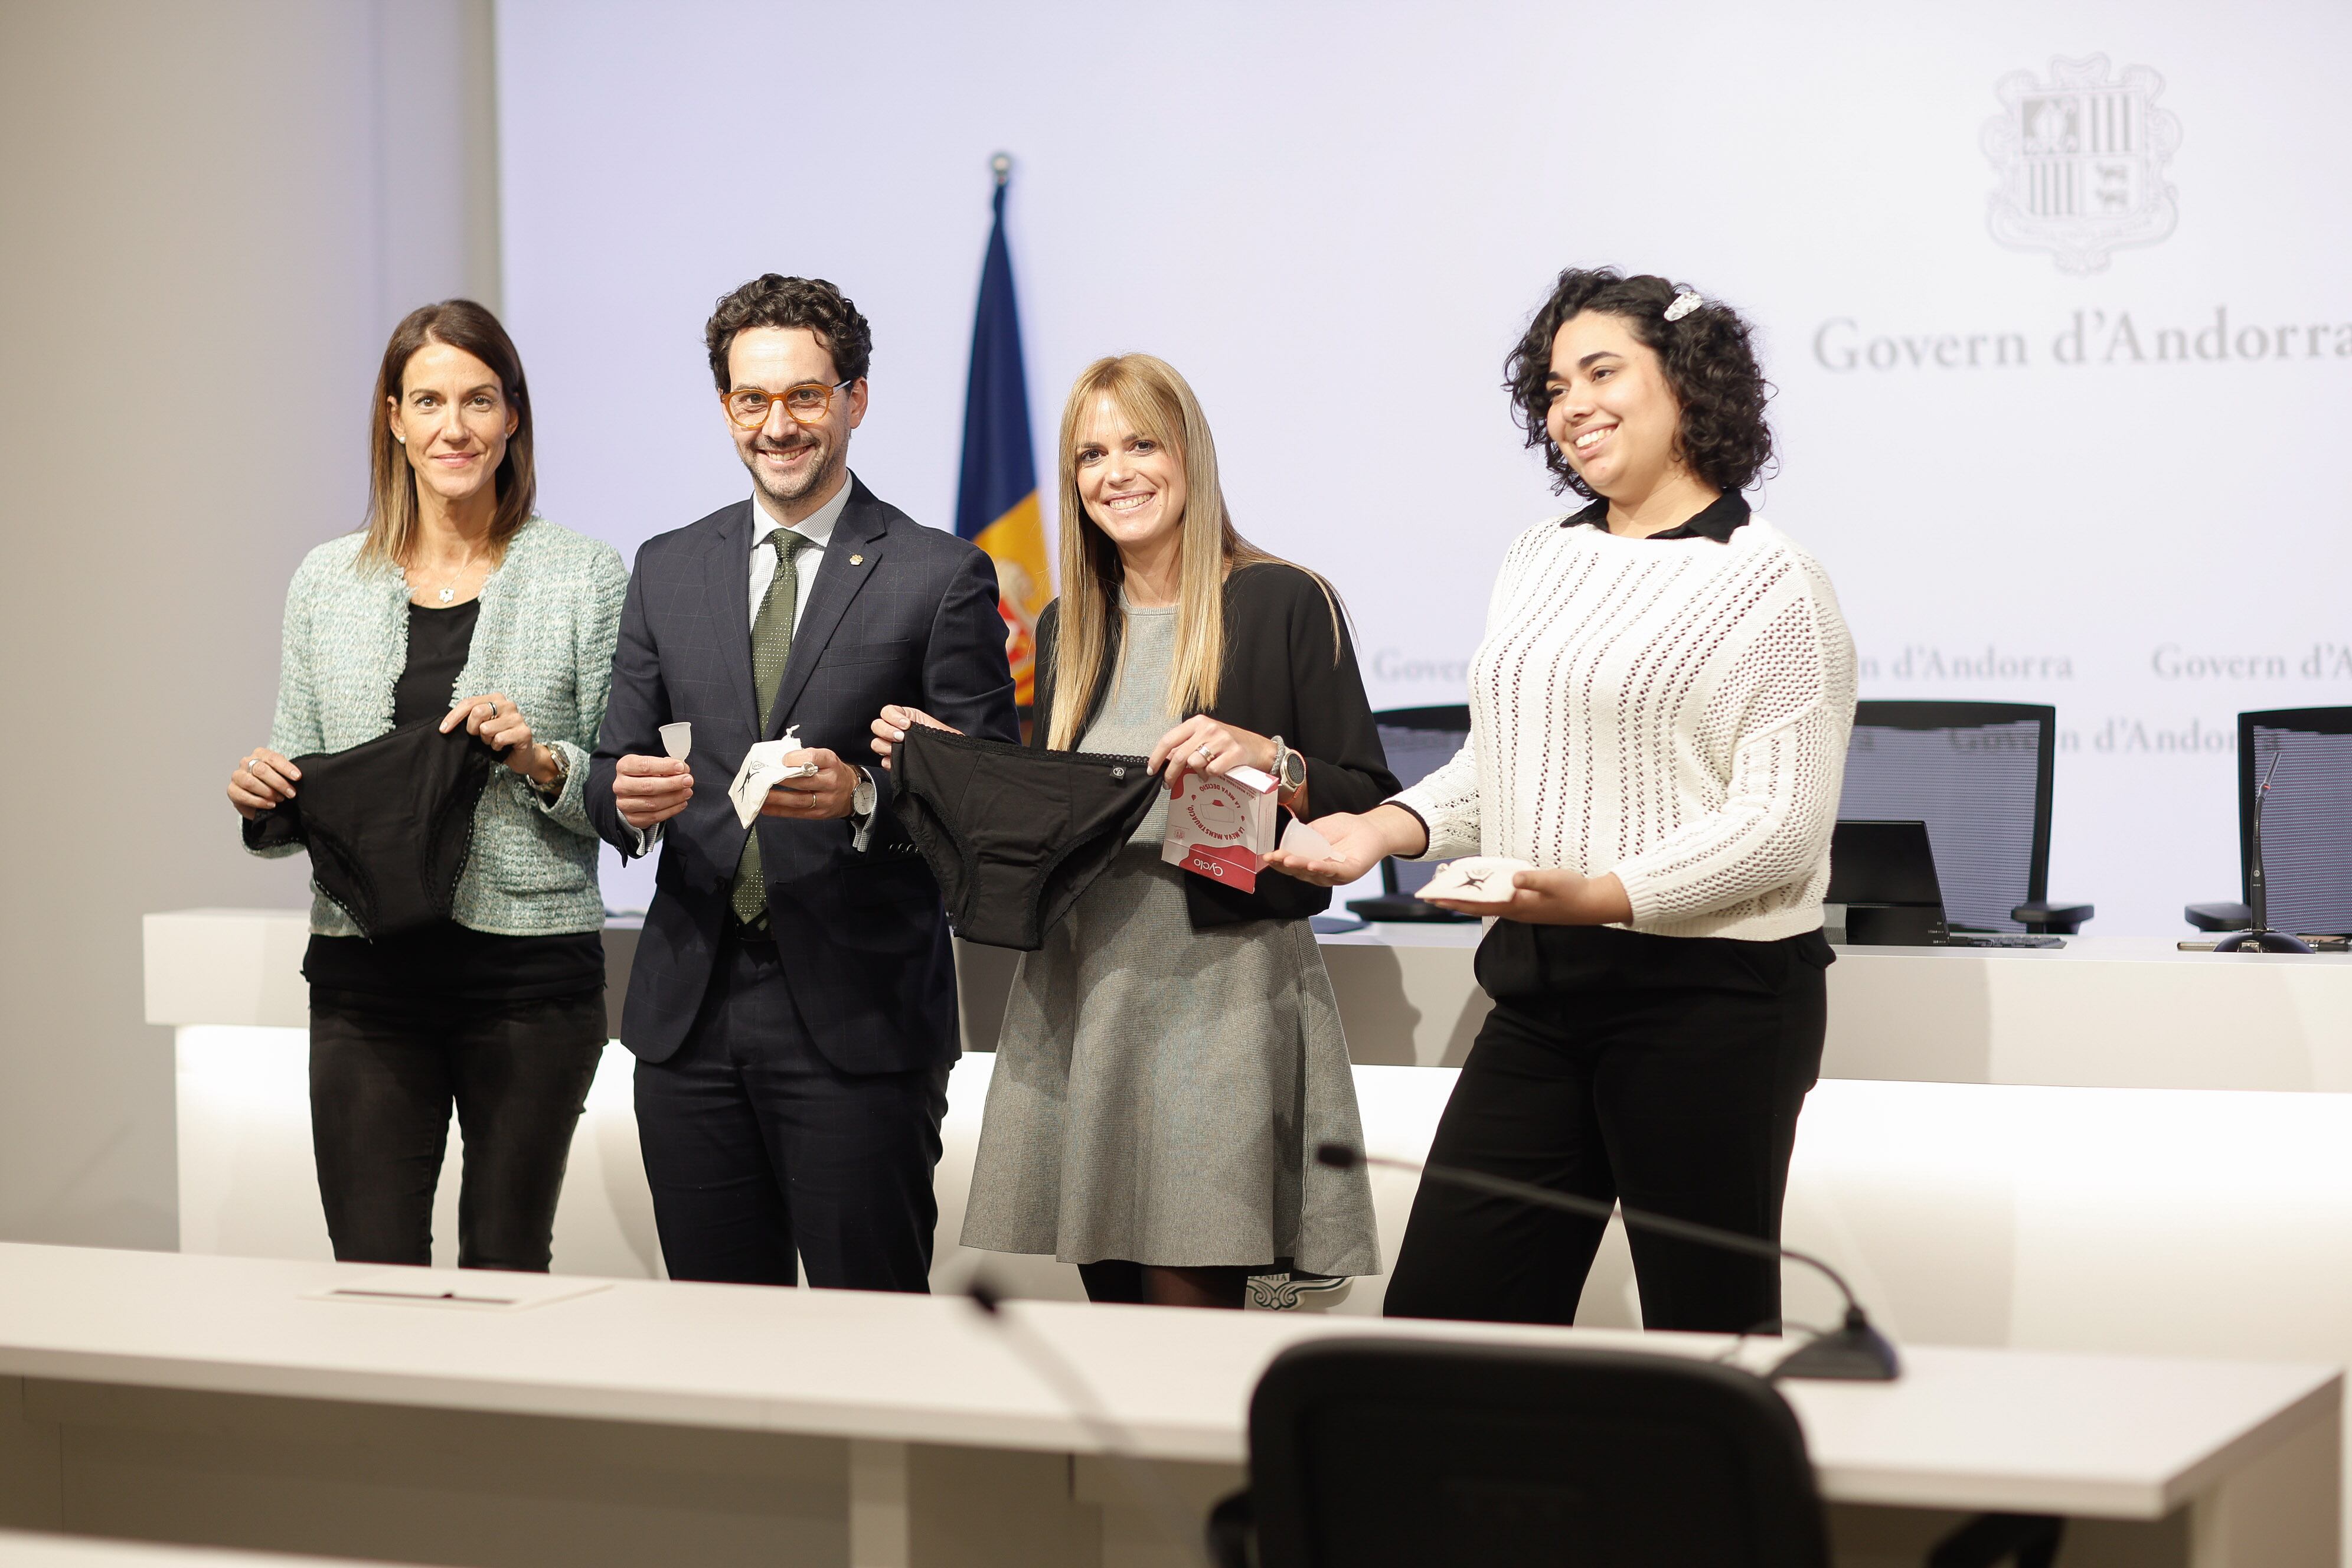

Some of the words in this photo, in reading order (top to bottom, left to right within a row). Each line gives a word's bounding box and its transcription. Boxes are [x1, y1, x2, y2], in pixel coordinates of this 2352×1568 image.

[1811, 315, 2028, 374] Govern
[2051, 303, 2352, 367] d'Andorra
[1891, 643, 2074, 682] d'Andorra
[2150, 641, 2287, 682] Govern
[1199, 783, 1220, 792] DECISIÓ
[1221, 786, 1236, 801] MEVA
[1224, 831, 1240, 840] MEVA
[1194, 858, 1223, 876] Cyclo
